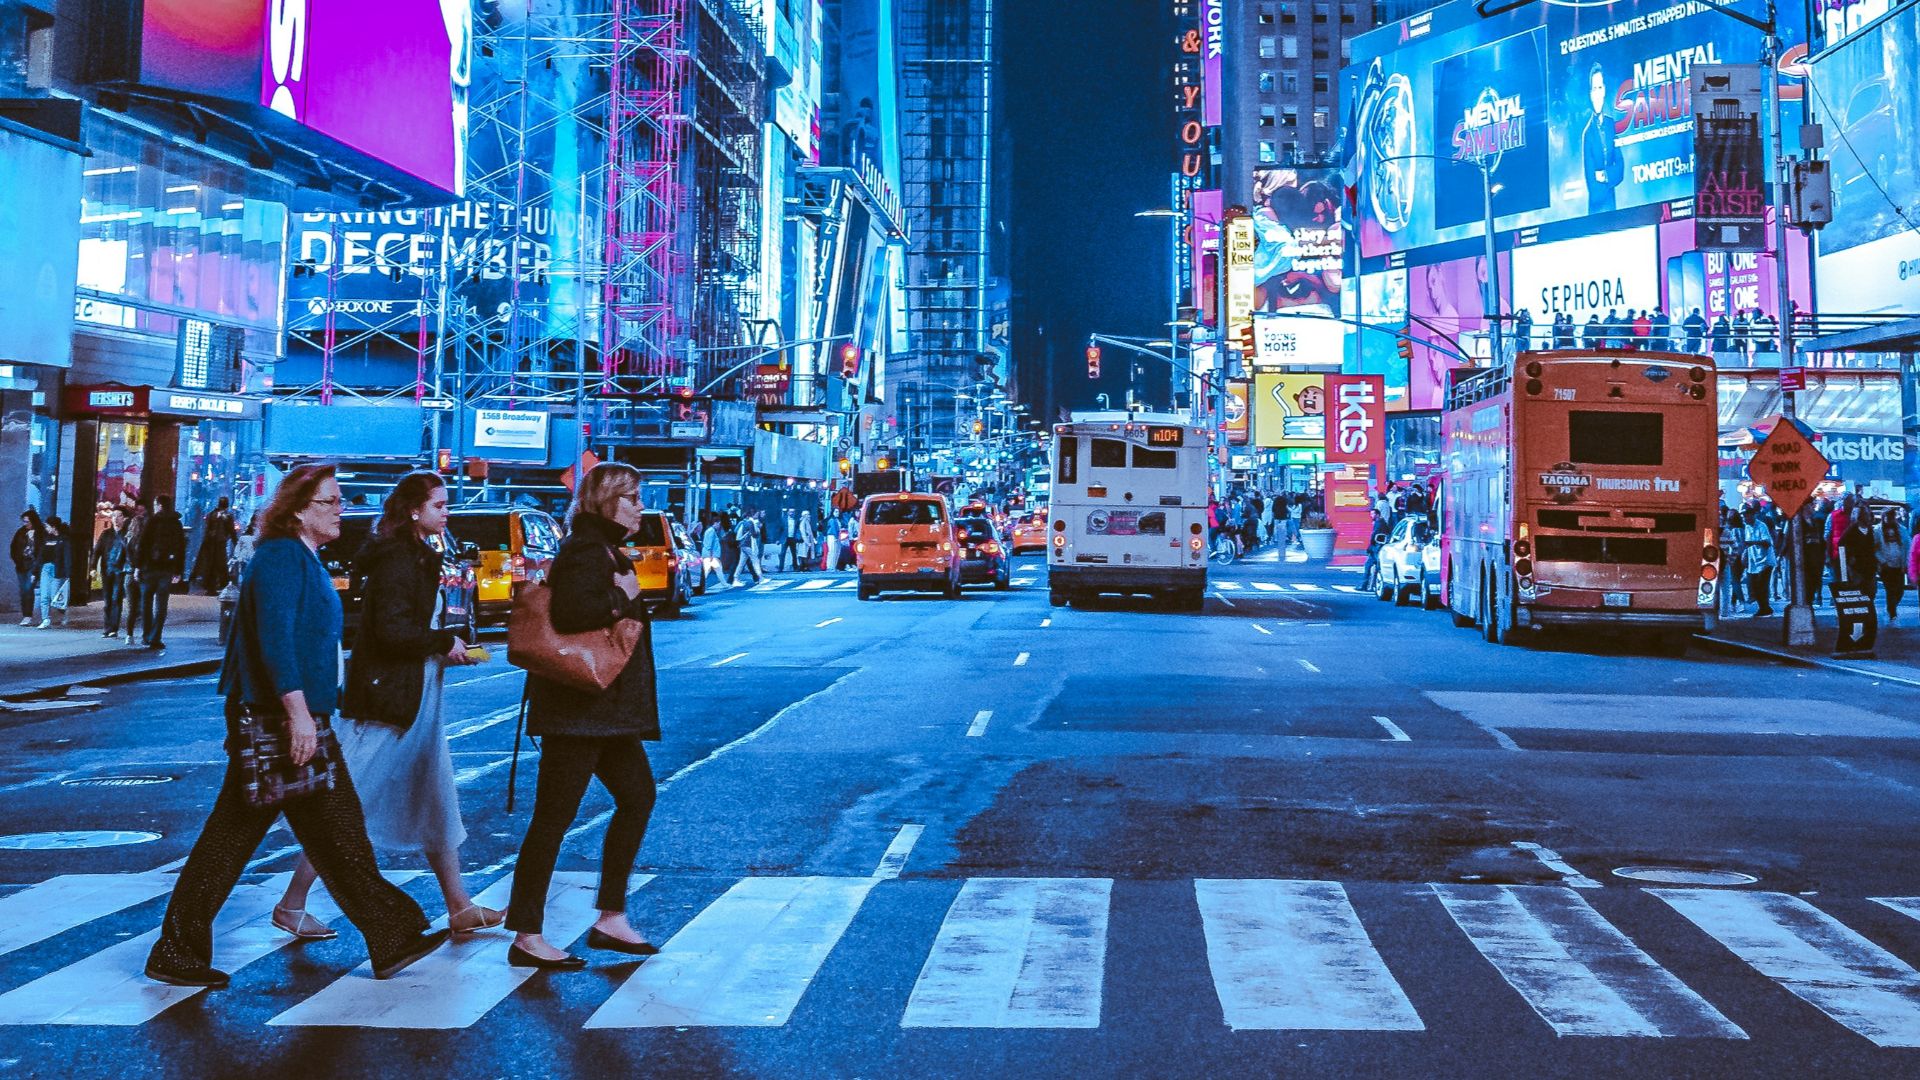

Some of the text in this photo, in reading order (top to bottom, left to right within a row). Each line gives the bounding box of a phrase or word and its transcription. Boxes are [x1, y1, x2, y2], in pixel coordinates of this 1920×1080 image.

[1647, 7, 1686, 28] STRAPPED
[1182, 29, 1201, 53] &
[1633, 42, 1722, 89] MENTAL
[1464, 94, 1525, 130] MENTAL
[1182, 86, 1201, 177] YOU
[1452, 116, 1527, 160] SAMURAI
[1632, 158, 1675, 184] TONIGHT
[1703, 171, 1758, 193] ALL
[1698, 193, 1764, 216] RISE
[1233, 240, 1251, 251] LION
[1234, 231, 1248, 239] THE
[301, 230, 552, 285] DECEMBER
[1231, 251, 1254, 266] KING
[1708, 252, 1758, 275] BU ONE
[1542, 277, 1625, 314] SEPHORA
[1734, 286, 1759, 310] ONE
[365, 301, 393, 314] ONE
[1264, 333, 1296, 341] YOUNG
[1264, 342, 1296, 351] MOMS
[482, 412, 542, 423] 1568 Broadway
[1340, 381, 1375, 453] tkts
[1772, 442, 1800, 455] ROAD
[1771, 461, 1801, 474] WORK
[1541, 475, 1589, 486] TACOMA
[1596, 478, 1650, 491] THURSDAYS
[1771, 479, 1807, 491] AHEAD
